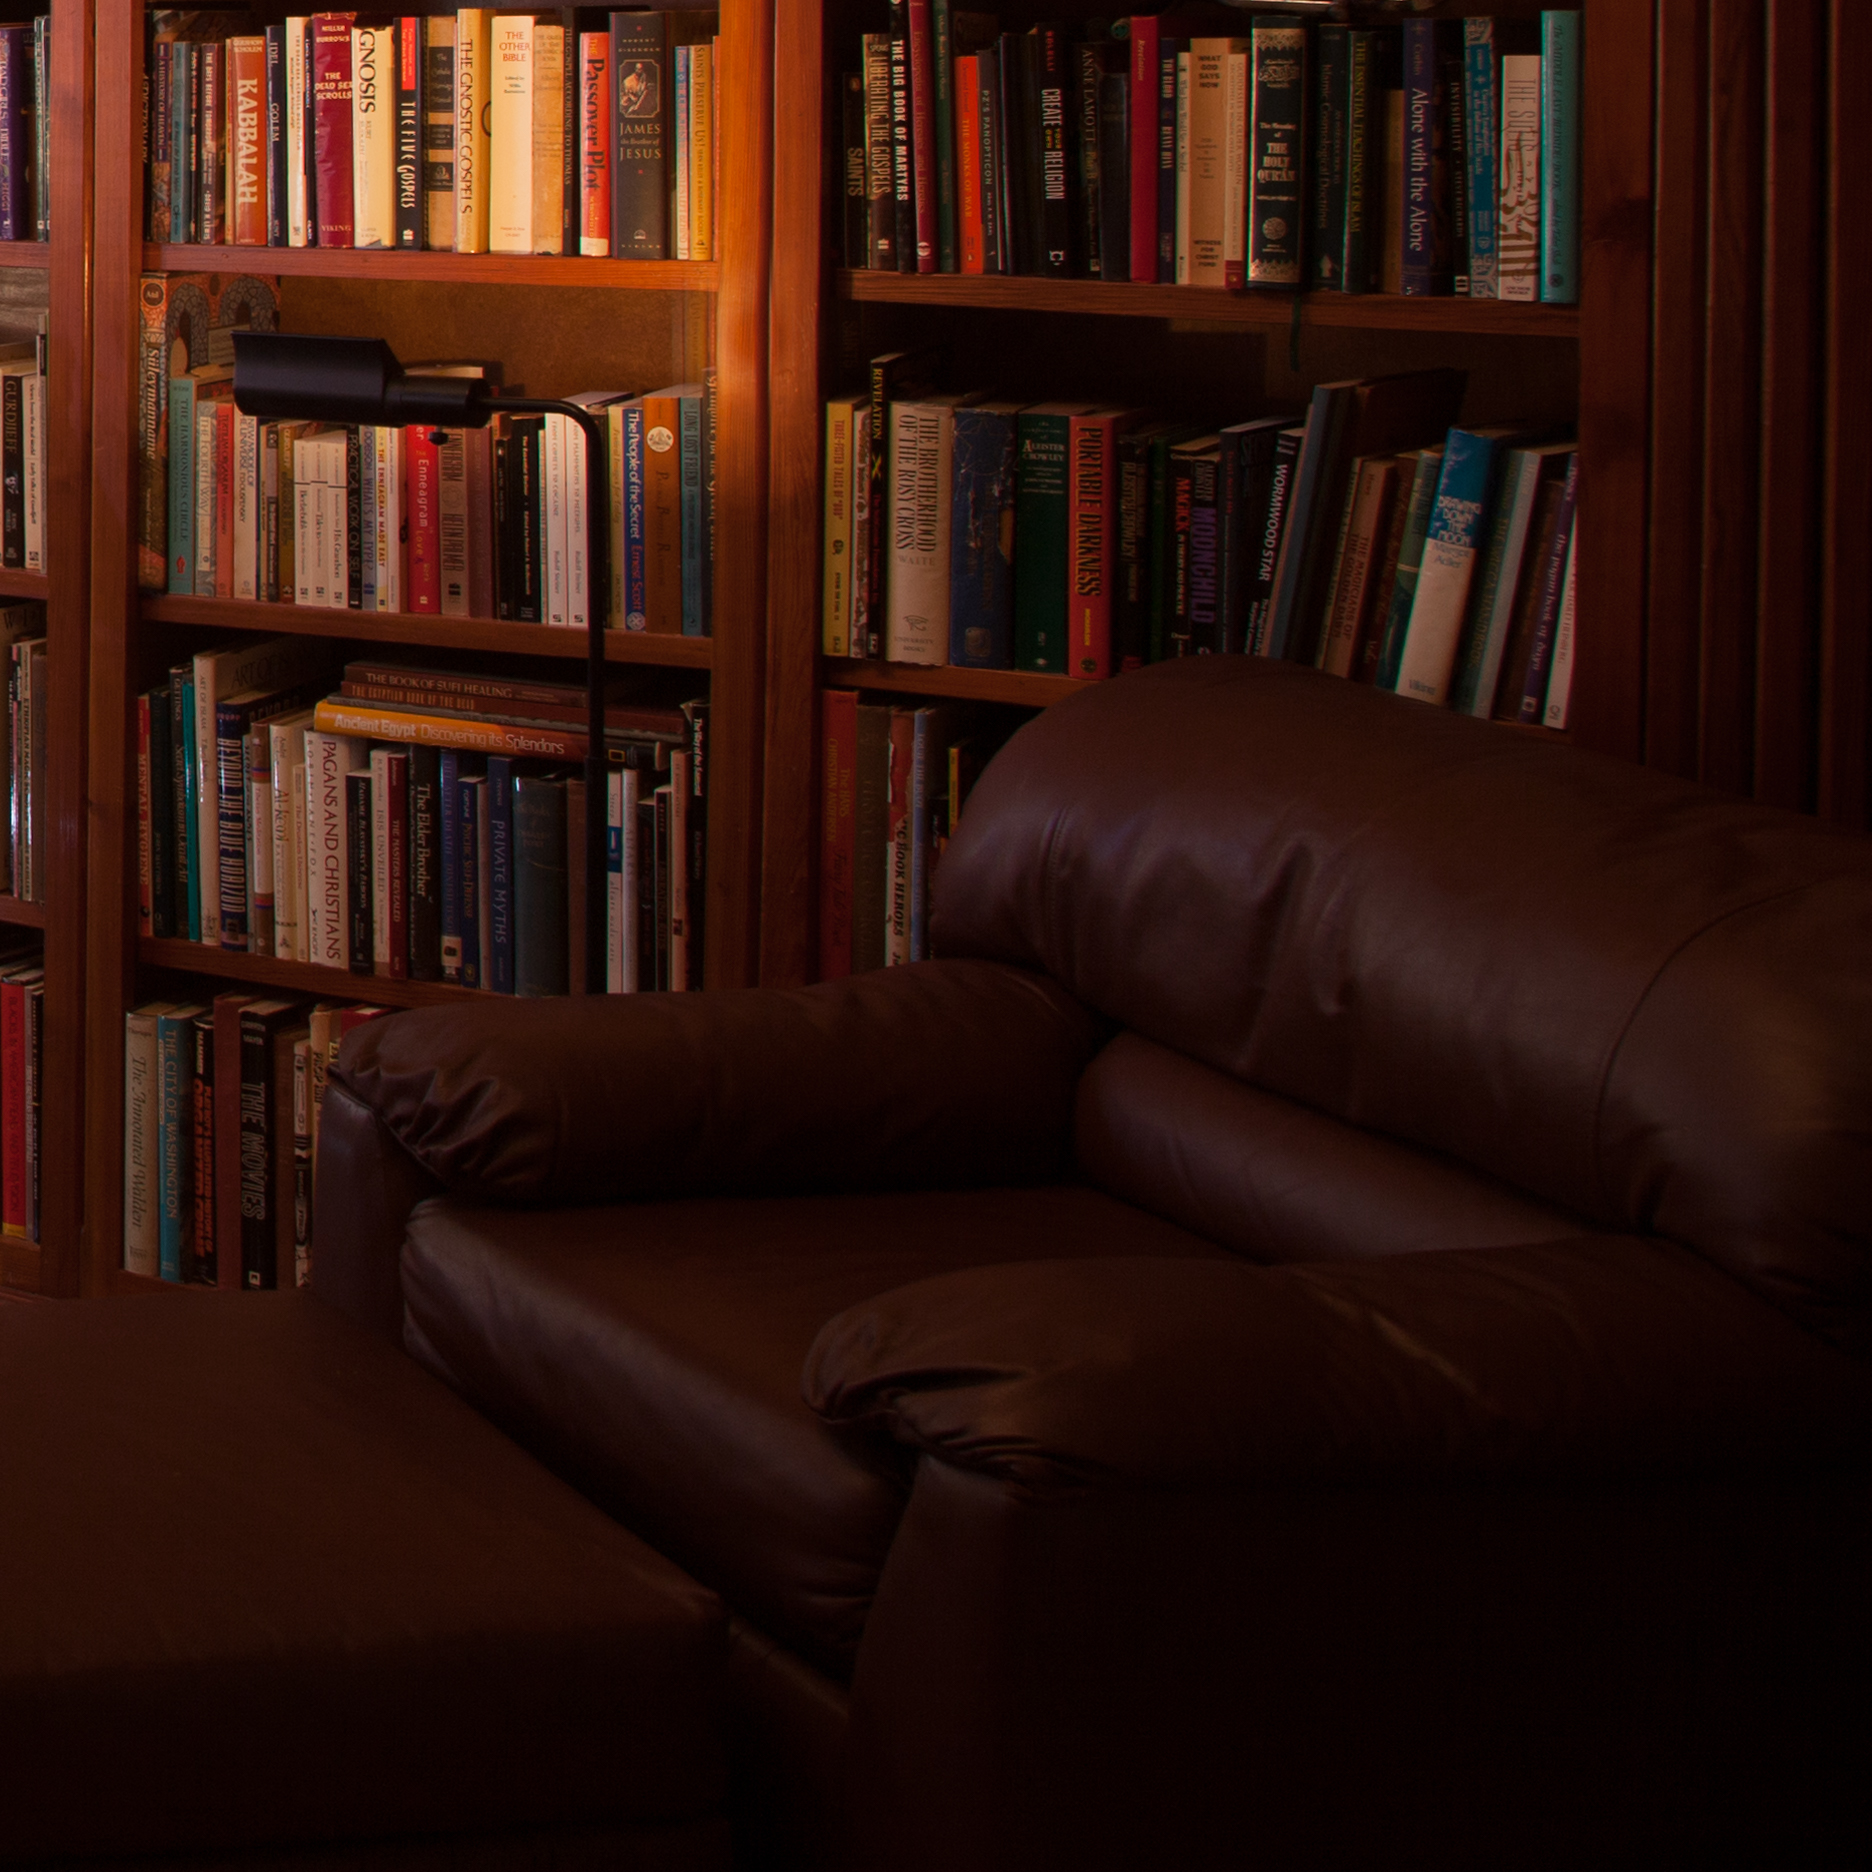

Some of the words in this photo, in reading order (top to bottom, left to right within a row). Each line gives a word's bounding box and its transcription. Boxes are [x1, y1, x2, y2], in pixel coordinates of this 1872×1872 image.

[460, 39, 473, 69] THE
[891, 39, 905, 61] THE
[1082, 50, 1094, 85] ANNE
[358, 31, 376, 114] GNOSIS
[868, 56, 890, 120] LIBERATING
[892, 65, 905, 86] BIG
[400, 101, 416, 125] THE
[460, 73, 474, 142] GNOSTIC
[893, 90, 906, 122] BOOK
[1083, 89, 1096, 143] LAMOTT
[1410, 88, 1429, 133] Alone
[237, 78, 258, 204] KABBALAH
[400, 130, 416, 160] FIVE
[870, 123, 890, 142] THE
[894, 127, 907, 141] OF
[846, 147, 863, 196] SAINTS
[870, 146, 891, 194] GOSPELS
[894, 146, 909, 201] MARTYRS
[1410, 137, 1428, 172] with
[397, 165, 416, 208] GOSPELS
[460, 146, 474, 214] GOSPELS
[1409, 176, 1428, 202] the
[1409, 206, 1427, 252] Alone
[4, 380, 17, 453] GURDJIEFF
[180, 398, 189, 421] THE
[627, 412, 640, 433] The
[872, 368, 884, 440] REVELATION
[899, 415, 917, 433] OF
[918, 416, 939, 444] THE
[180, 424, 189, 498] HARMONIOUS
[348, 434, 360, 490] PRACTICAL
[626, 434, 640, 471] People
[898, 436, 916, 466] THE
[1074, 427, 1103, 508] PORTABLE
[416, 459, 429, 527] Enneagram
[628, 472, 640, 484] of
[628, 485, 641, 503] the
[897, 470, 916, 503] ROSY
[349, 494, 360, 529] WORK
[916, 449, 939, 552] BROTHERHOOD
[1262, 464, 1288, 548] WORMWOOD
[180, 502, 189, 542] CIRCLE
[629, 503, 641, 539] Secret
[896, 507, 915, 550] CROSS
[349, 531, 360, 551] ON
[1074, 512, 1102, 596] DARKNESS
[349, 556, 360, 578] SELF
[631, 544, 642, 579] Ernest
[1190, 507, 1217, 624] MOONCHILD
[1258, 549, 1274, 581] STAR
[631, 581, 642, 610] Scott
[333, 715, 379, 728] Ancient
[381, 721, 417, 739] Egypt
[216, 738, 242, 788] BEYOND
[322, 741, 340, 806] PAGANS
[218, 794, 243, 816] THE
[416, 784, 430, 811] The
[218, 820, 244, 851] BLUE
[323, 810, 340, 850] AND
[416, 812, 430, 846] Elder
[492, 819, 506, 883] PRIVATE
[416, 847, 430, 897] Brother
[324, 855, 341, 959] CHRISTIANS
[494, 889, 507, 943] MYTHS
[165, 1030, 176, 1057] THE
[131, 1056, 147, 1083] The
[165, 1061, 177, 1095] CITY
[165, 1098, 177, 1118] OF
[241, 1082, 266, 1127] THE
[131, 1088, 147, 1166] Annotated
[165, 1122, 178, 1219] WASHINGTON
[241, 1131, 266, 1221] MOVIES
[131, 1170, 147, 1228] Walden
